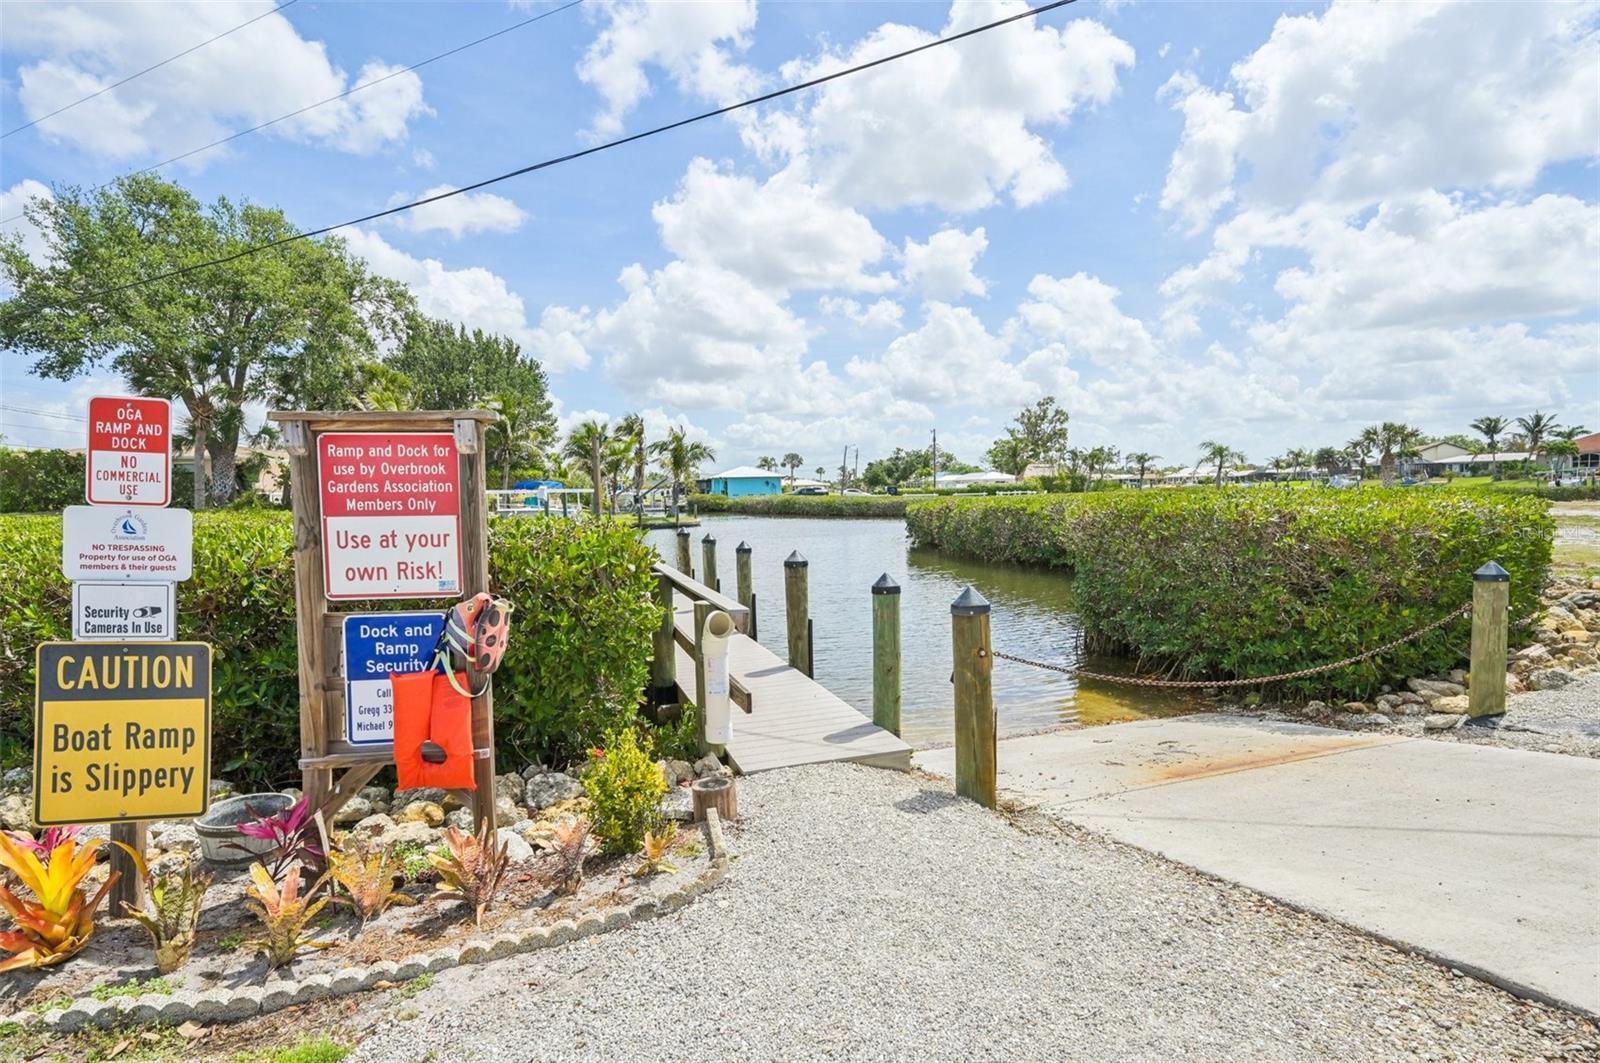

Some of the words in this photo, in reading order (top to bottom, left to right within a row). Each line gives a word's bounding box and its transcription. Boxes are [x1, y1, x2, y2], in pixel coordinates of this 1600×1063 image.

[117, 408, 142, 420] OGA
[96, 421, 132, 434] RAMP
[136, 424, 162, 436] AND
[112, 437, 146, 450] DOCK
[327, 444, 364, 459] Ramp
[368, 445, 392, 457] and
[398, 444, 428, 457] Dock
[434, 444, 450, 456] for
[121, 456, 137, 468] NO
[96, 470, 160, 483] COMMERCIAL
[333, 465, 355, 475] use
[360, 463, 376, 478] by
[381, 462, 446, 475] Overbrook
[120, 484, 138, 495] USE
[328, 480, 379, 493] Gardens
[384, 480, 453, 492] Association
[346, 498, 403, 511] Members
[408, 498, 436, 512] Only
[108, 544, 165, 552] TRESPASSING
[336, 530, 371, 549] Use
[380, 530, 398, 548] at
[405, 533, 450, 552] your
[80, 553, 116, 562] Property
[345, 566, 388, 581] own
[397, 560, 442, 580] Risk!
[84, 606, 130, 620] Security
[84, 621, 128, 634] Cameras
[132, 621, 141, 634] In
[144, 622, 162, 634] Use
[360, 625, 398, 638] Dock
[404, 624, 432, 636] and
[375, 642, 418, 656] Ramp
[57, 655, 193, 690] CAUTION
[366, 658, 428, 673] Security
[376, 688, 392, 698] Call
[358, 706, 380, 717] Gregg
[356, 721, 385, 731] Michael
[53, 722, 112, 752] Boat
[126, 722, 195, 755] Ramp
[51, 765, 72, 793] is
[85, 763, 194, 797] Slippery
